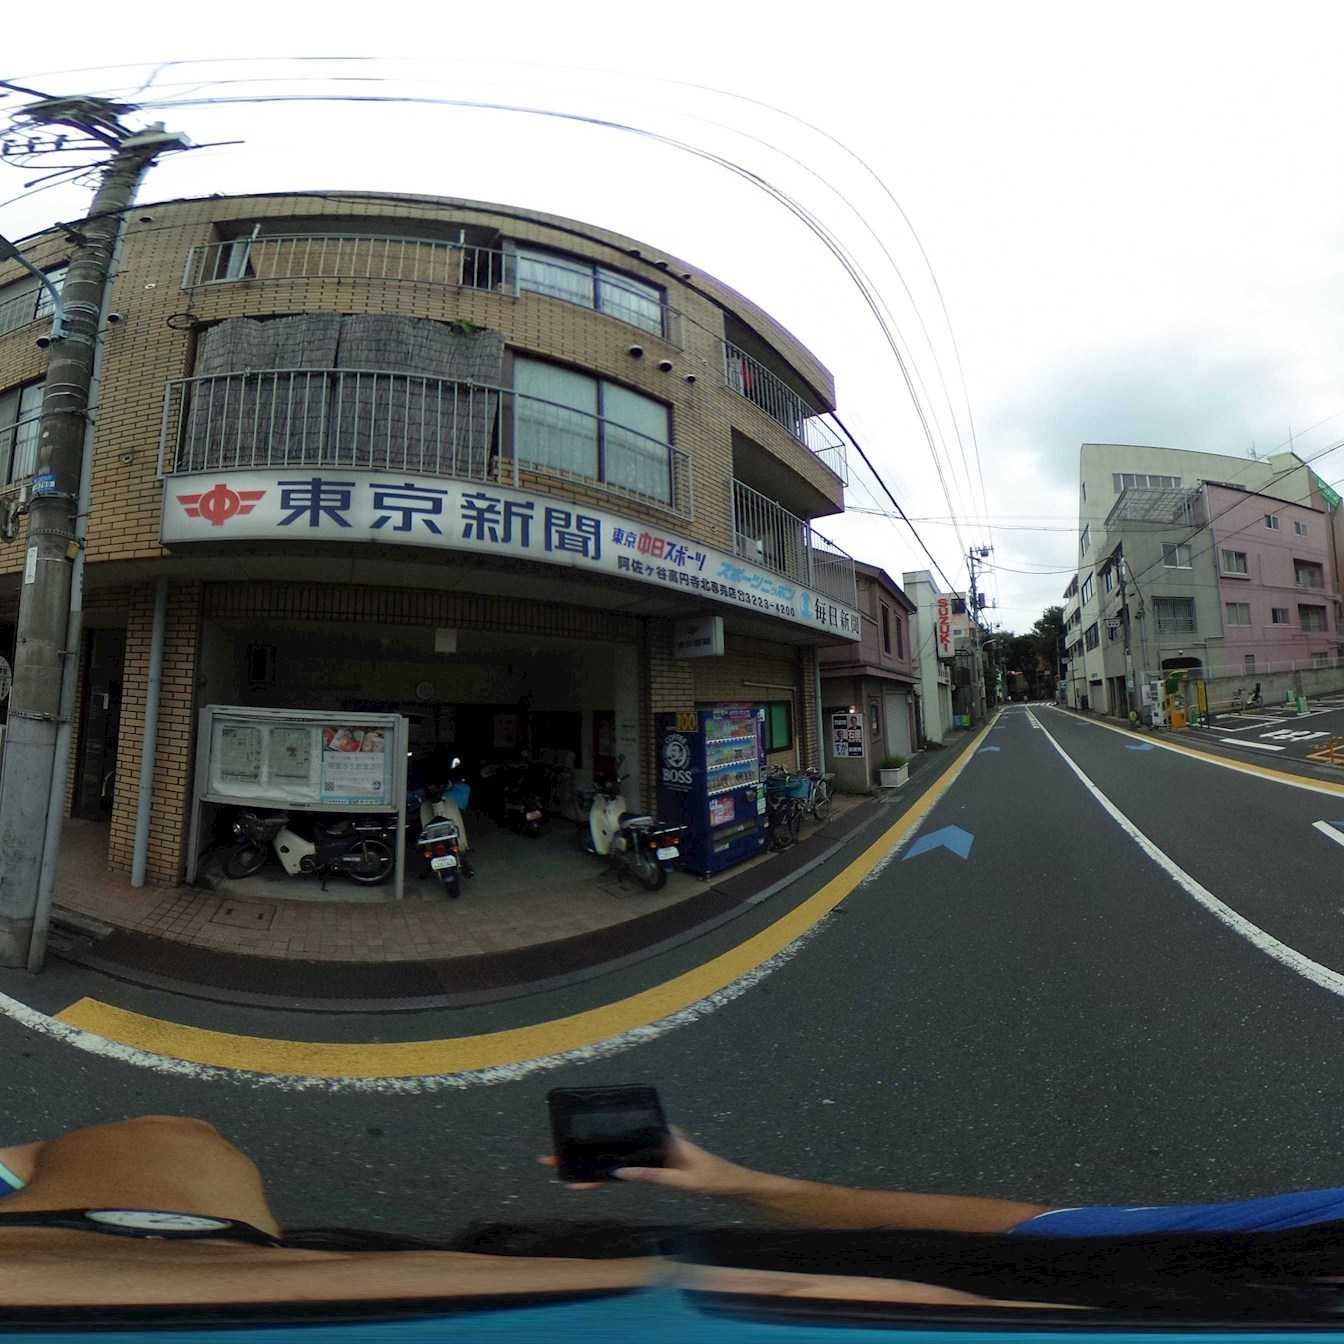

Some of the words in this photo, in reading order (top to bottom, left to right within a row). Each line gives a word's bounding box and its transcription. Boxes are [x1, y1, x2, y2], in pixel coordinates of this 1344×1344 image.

[276, 477, 602, 561] 東京新聞
[814, 598, 860, 635] 毎日新聞
[937, 598, 951, 652] SUZUKI
[662, 768, 693, 784] BOSS
